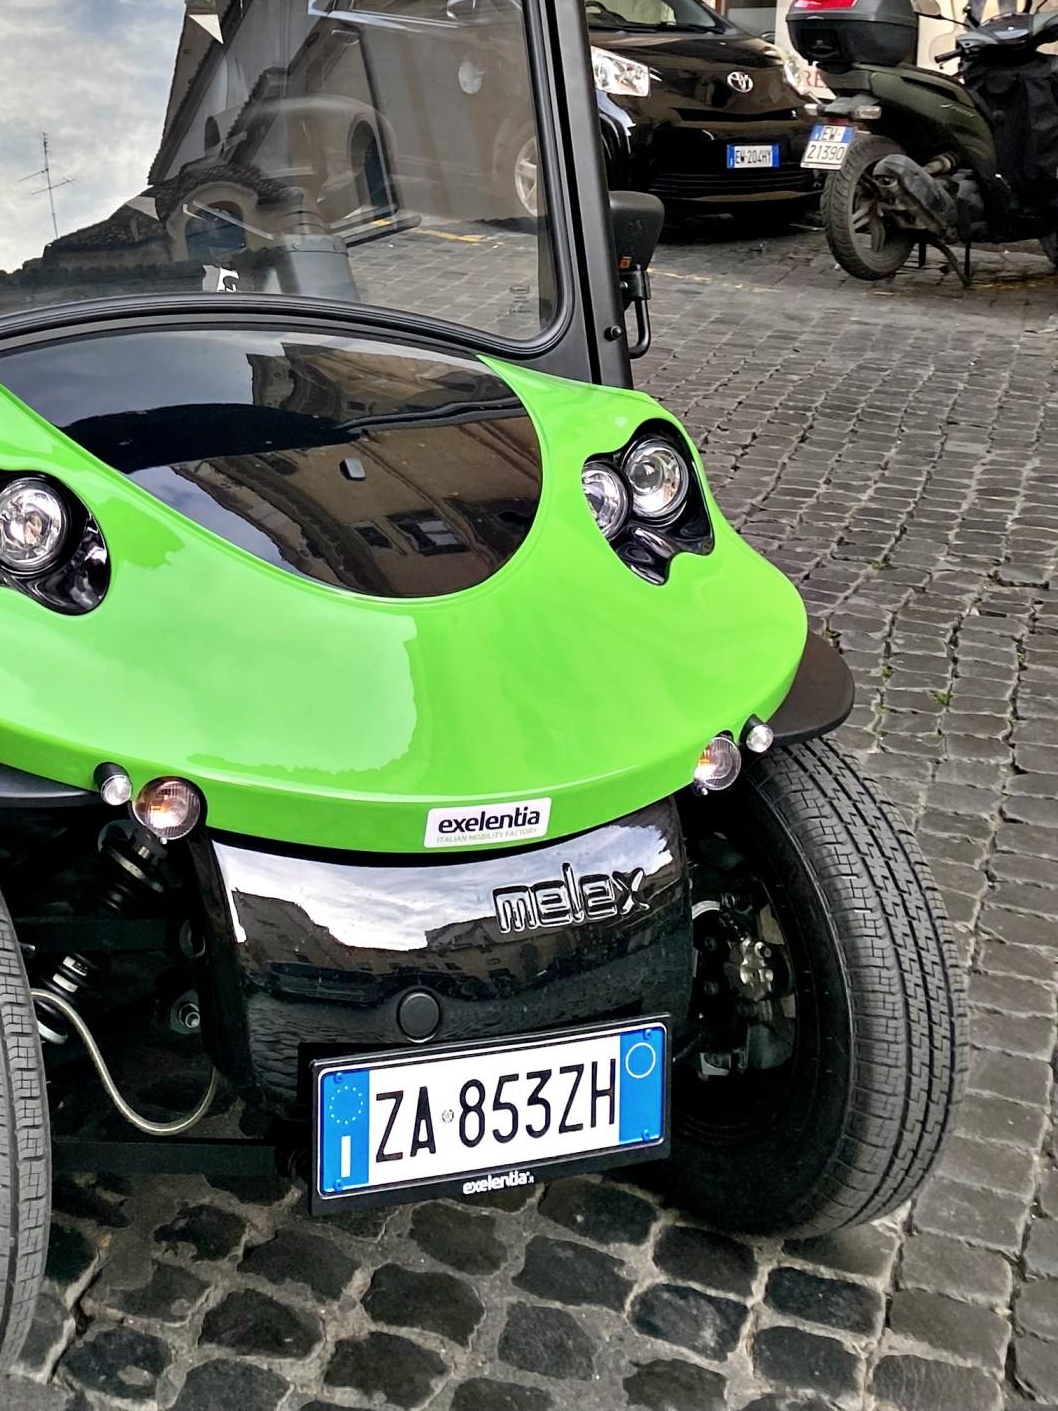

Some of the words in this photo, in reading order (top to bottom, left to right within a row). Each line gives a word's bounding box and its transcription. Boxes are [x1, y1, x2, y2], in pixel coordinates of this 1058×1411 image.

[807, 144, 844, 160] 21390
[438, 806, 540, 834] exelentia
[437, 834, 467, 844] ITALIAN
[468, 831, 503, 841] MOBILITY
[504, 827, 537, 838] FACTORY
[492, 862, 650, 934] melex
[375, 1085, 437, 1164] ZA
[458, 1058, 617, 1149] 853ZH
